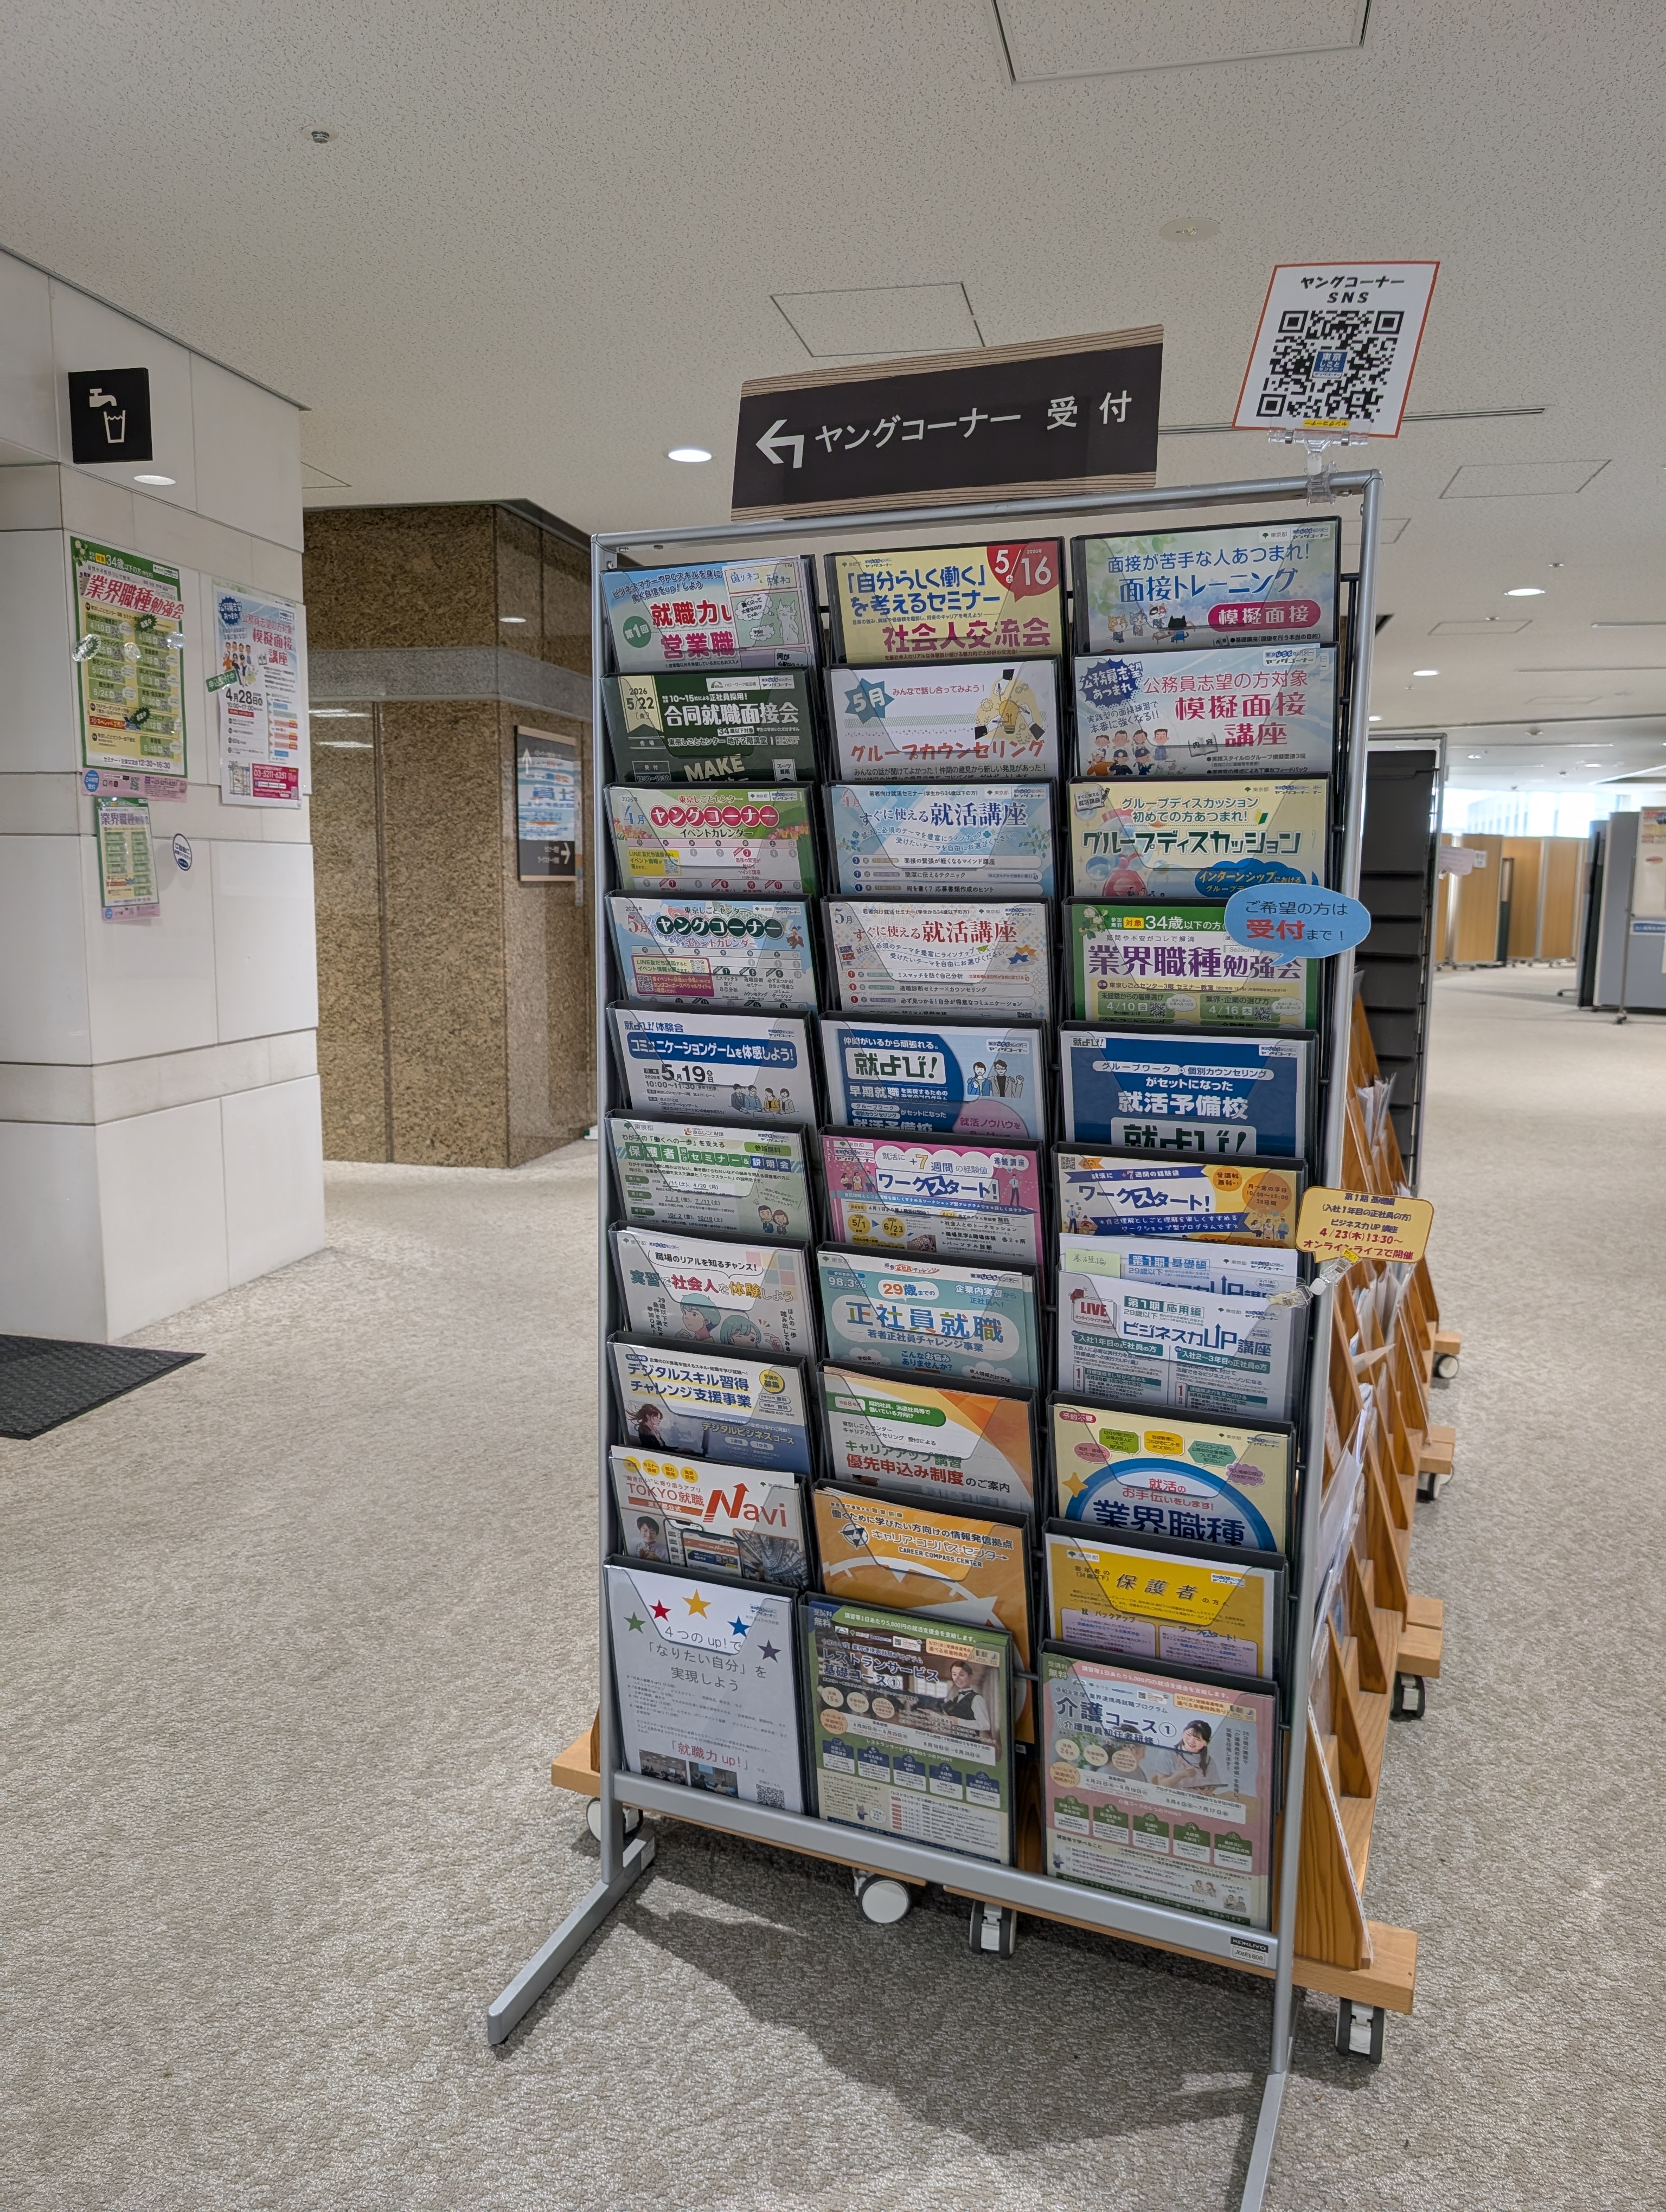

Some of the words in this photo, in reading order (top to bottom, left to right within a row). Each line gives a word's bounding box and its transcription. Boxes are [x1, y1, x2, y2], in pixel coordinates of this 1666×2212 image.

[1300, 275, 1405, 289] ヤングコーナー
[1327, 292, 1369, 304] SNS
[1323, 353, 1341, 362] 東京
[815, 407, 1021, 453] ヤングコーナー
[995, 549, 1052, 586] 5/16
[1107, 543, 1309, 574] 面接が苦手な人あつまれ!
[848, 564, 987, 594] 「自分らしく働く」
[1119, 568, 1298, 603] 面接トレーニング
[85, 575, 184, 620] 業界職種勉強会
[850, 589, 1000, 617] を考えるセミナー
[1218, 605, 1309, 626] 模擬面接
[253, 628, 293, 651] 模擬面接
[625, 623, 650, 639] 第1回
[882, 617, 1051, 653] 社会人交流会
[660, 631, 736, 659] 営業職
[268, 648, 289, 666] 講座
[1081, 662, 1143, 689] 公務員志望
[1143, 670, 1308, 695] 公務員志望の方対象
[853, 688, 885, 712] 5月
[892, 685, 985, 696] みんなで話し合ってみよう！
[1093, 682, 1133, 700] あつまれ
[627, 697, 655, 711] 5/22
[1175, 692, 1306, 721] 模擬面接
[664, 702, 799, 727] 合同就職面接会
[1224, 722, 1288, 748] 講座
[851, 740, 1045, 762] グループカウンセリング
[684, 754, 745, 782] MAKE
[679, 794, 743, 804] 東京しごとセンター
[1121, 797, 1259, 810] グループディスカッション
[624, 805, 645, 825] 4月
[652, 808, 777, 824] ヤングコーナー
[859, 802, 1027, 827] すぐに使える就活講座
[1132, 811, 1248, 824] 初めての方あつまれ!
[680, 828, 753, 839] イベントカレンダー
[1083, 830, 1302, 855] グループディスカッション
[684, 906, 747, 915] 東京しごとセンター
[1246, 901, 1348, 916] ご希望の方は
[627, 914, 648, 934] 5月
[657, 919, 781, 935] ヤングコーナー
[853, 919, 1018, 943] すぐに使える就活講座
[1126, 919, 1143, 929] 対象
[1246, 918, 1344, 941] 受付まで!
[685, 937, 758, 948] イベントカレンダー
[1106, 934, 1195, 943] 疑問や不安がコレで解消
[1088, 944, 1302, 980] 業界職種勉強会
[1106, 1002, 1136, 1012] 4/10
[1208, 1006, 1239, 1015] 4/16
[630, 1038, 794, 1062] コミュニケーションゲームを体感しよう!
[843, 1036, 939, 1050] 仲間がいるから頑張れる。
[1073, 1037, 1104, 1047] 就よび!
[854, 1052, 938, 1079] 就よび!
[1101, 1062, 1171, 1073] グループワーク
[1188, 1066, 1267, 1079] 個別カウンセリング
[645, 1080, 695, 1090] 10:00～11:30
[849, 1085, 900, 1099] 早期就職
[1145, 1077, 1233, 1091] がセットになった
[901, 1110, 947, 1119] がセットになった
[1118, 1091, 1249, 1120] 就活予備校
[960, 1117, 1021, 1129] 就活ノウハウを
[621, 1134, 725, 1148] わが子の「働くへの一歩」を支える
[628, 1144, 790, 1171] 保護者向けセミナー&説明会
[882, 1152, 905, 1161] 就活に
[994, 1156, 1026, 1167] 連続講座
[878, 1173, 998, 1200] ワークスタート!
[1078, 1185, 1210, 1212] ワークスタート!
[1322, 1204, 1412, 1221] (入社1年目の正社員の方)
[655, 1251, 758, 1271] 職場のリアルを知るチャンス!
[1172, 1258, 1208, 1270] 基礎編
[1128, 1268, 1163, 1276] 29歳以下
[629, 1270, 793, 1302] 実習で社会人を体験しよう
[828, 1276, 867, 1290] 98.3%
[882, 1283, 936, 1297] 29歳までの
[955, 1284, 1017, 1300] 企業内実習から
[1080, 1301, 1107, 1317] LIVE
[1123, 1309, 1158, 1320] 29歳以下
[1127, 1297, 1162, 1312] 第1期
[1166, 1302, 1202, 1317] 応用編
[845, 1301, 1004, 1343] 正社員就職
[867, 1329, 985, 1353] 若者正社員チャレンジ事業
[1079, 1335, 1157, 1354] 入社1年目の正社員の方
[1123, 1321, 1272, 1357] ビジネス力UP講座
[902, 1358, 953, 1371] ありませんか?
[1182, 1353, 1268, 1372] 入社2～3年目の正社員の方
[627, 1363, 750, 1392] デジタルスキル習得
[630, 1380, 752, 1408] チャレンジ支援事業
[702, 1421, 795, 1444] デジタルビジネスコース
[846, 1453, 1010, 1493] 優先申込み制度のご案内
[1149, 1478, 1187, 1493] 就活の
[626, 1482, 704, 1507] TOKYO就職
[702, 1482, 787, 1527] Navi
[1123, 1486, 1214, 1510] お手伝いをします!
[832, 1509, 1014, 1549] 働くために学びたい方向けの情報発信拠点
[1093, 1499, 1246, 1546] 業界職種
[898, 1547, 924, 1557] CAREER
[925, 1551, 954, 1562] COMPASS
[956, 1556, 983, 1568] CENTER
[1116, 1573, 1197, 1601] 保護者
[649, 1641, 766, 1679] 「なりたい自分」を
[822, 1649, 940, 1682] レストランサービス
[671, 1666, 739, 1692] 実現しよう
[1048, 1669, 1068, 1681] 無料
[1233, 1938, 1267, 1950] KOKUYO
[1252, 1953, 1264, 1962] 606
